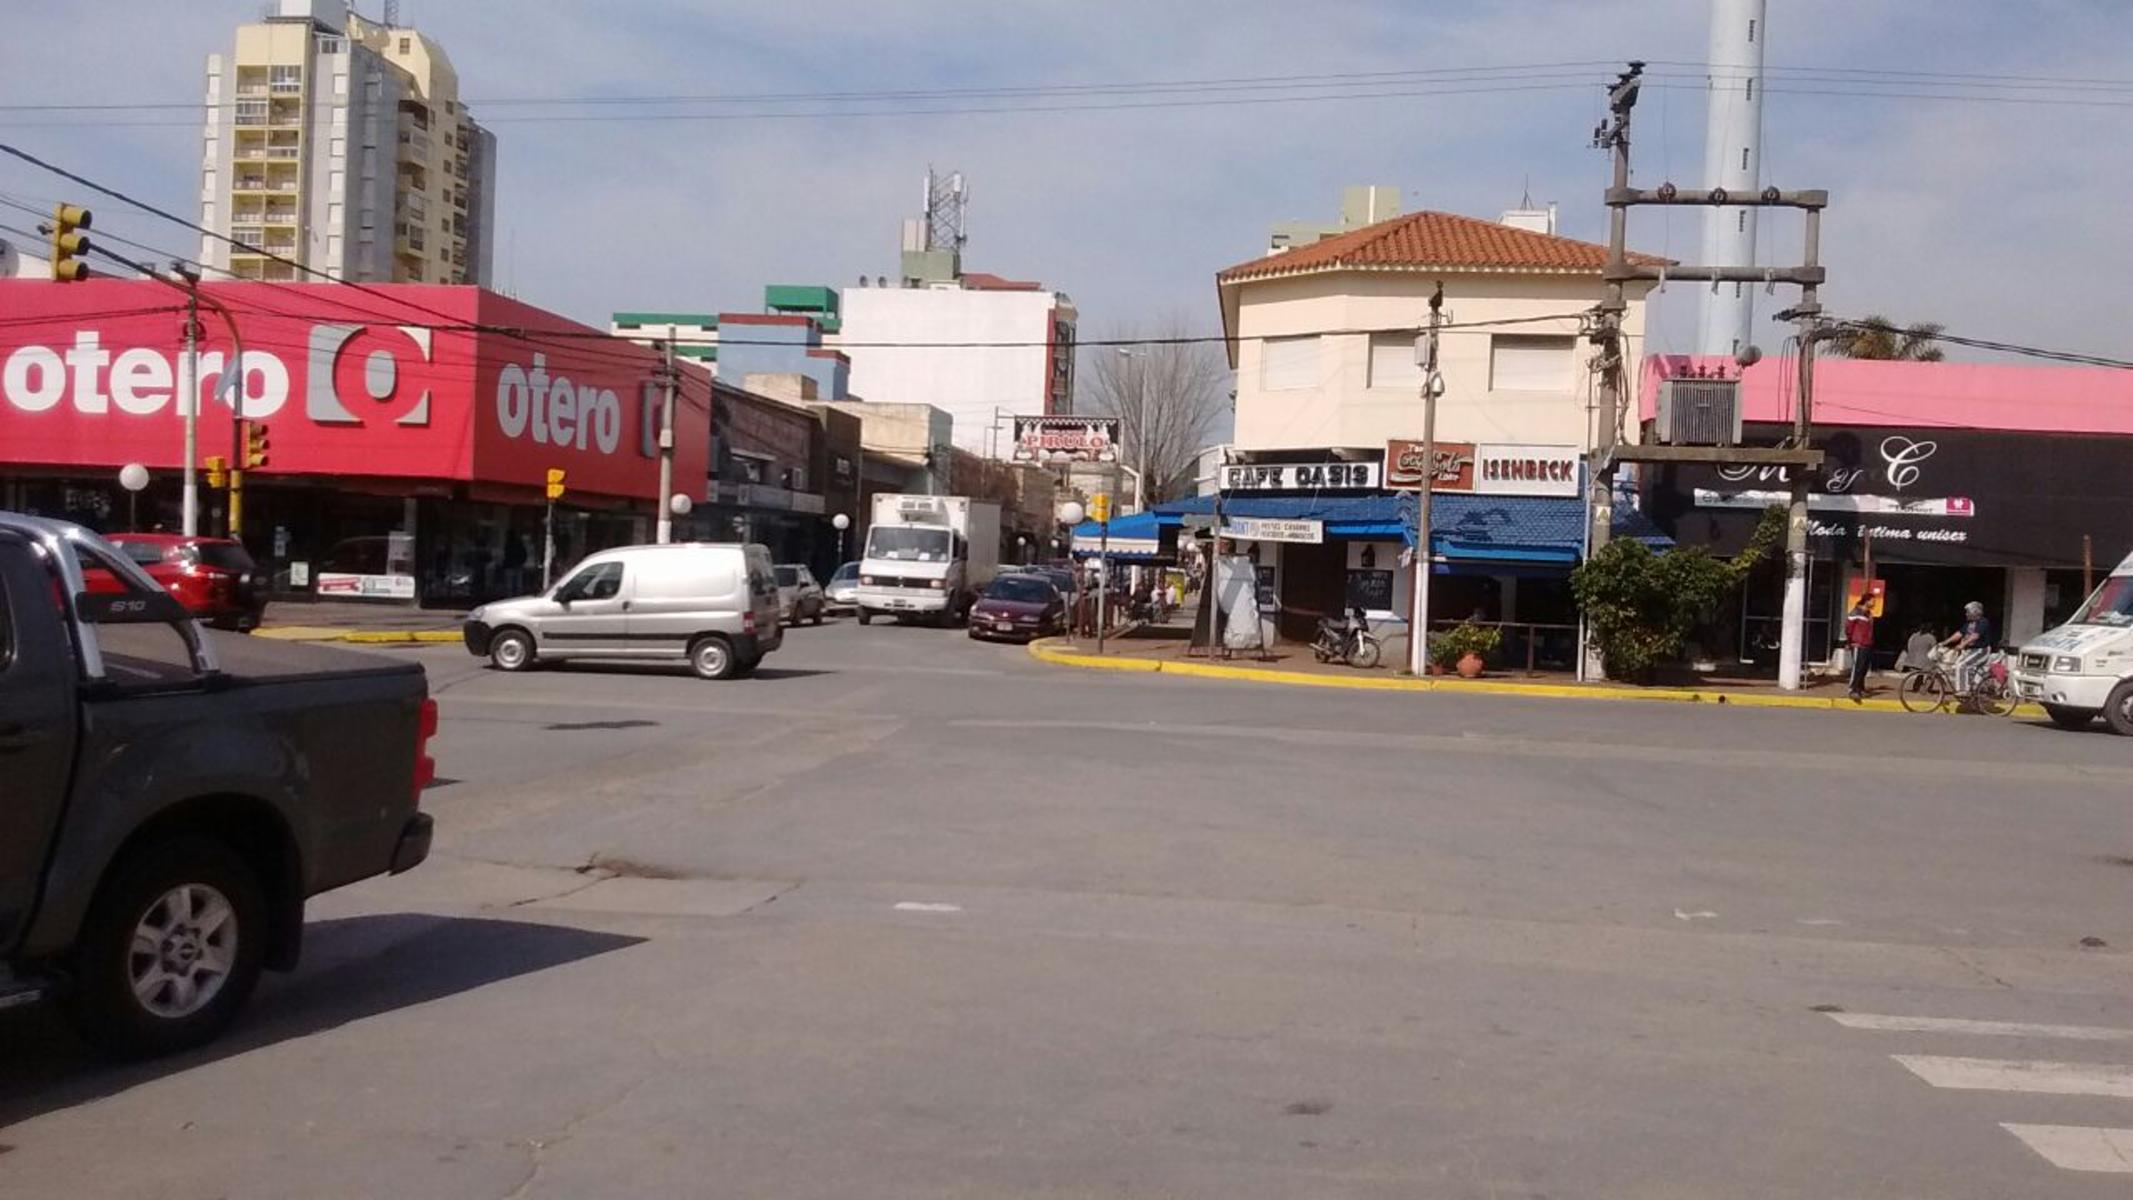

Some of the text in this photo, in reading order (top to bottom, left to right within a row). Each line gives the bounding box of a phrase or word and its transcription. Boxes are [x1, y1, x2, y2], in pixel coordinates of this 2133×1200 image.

[3, 330, 290, 418] otero
[496, 351, 621, 455] otero
[1025, 434, 1105, 449] PIRULO
[1227, 464, 1369, 488] CAFE OASIS
[1482, 459, 1574, 482] ISENBECK
[1916, 528, 1968, 542] unisex
